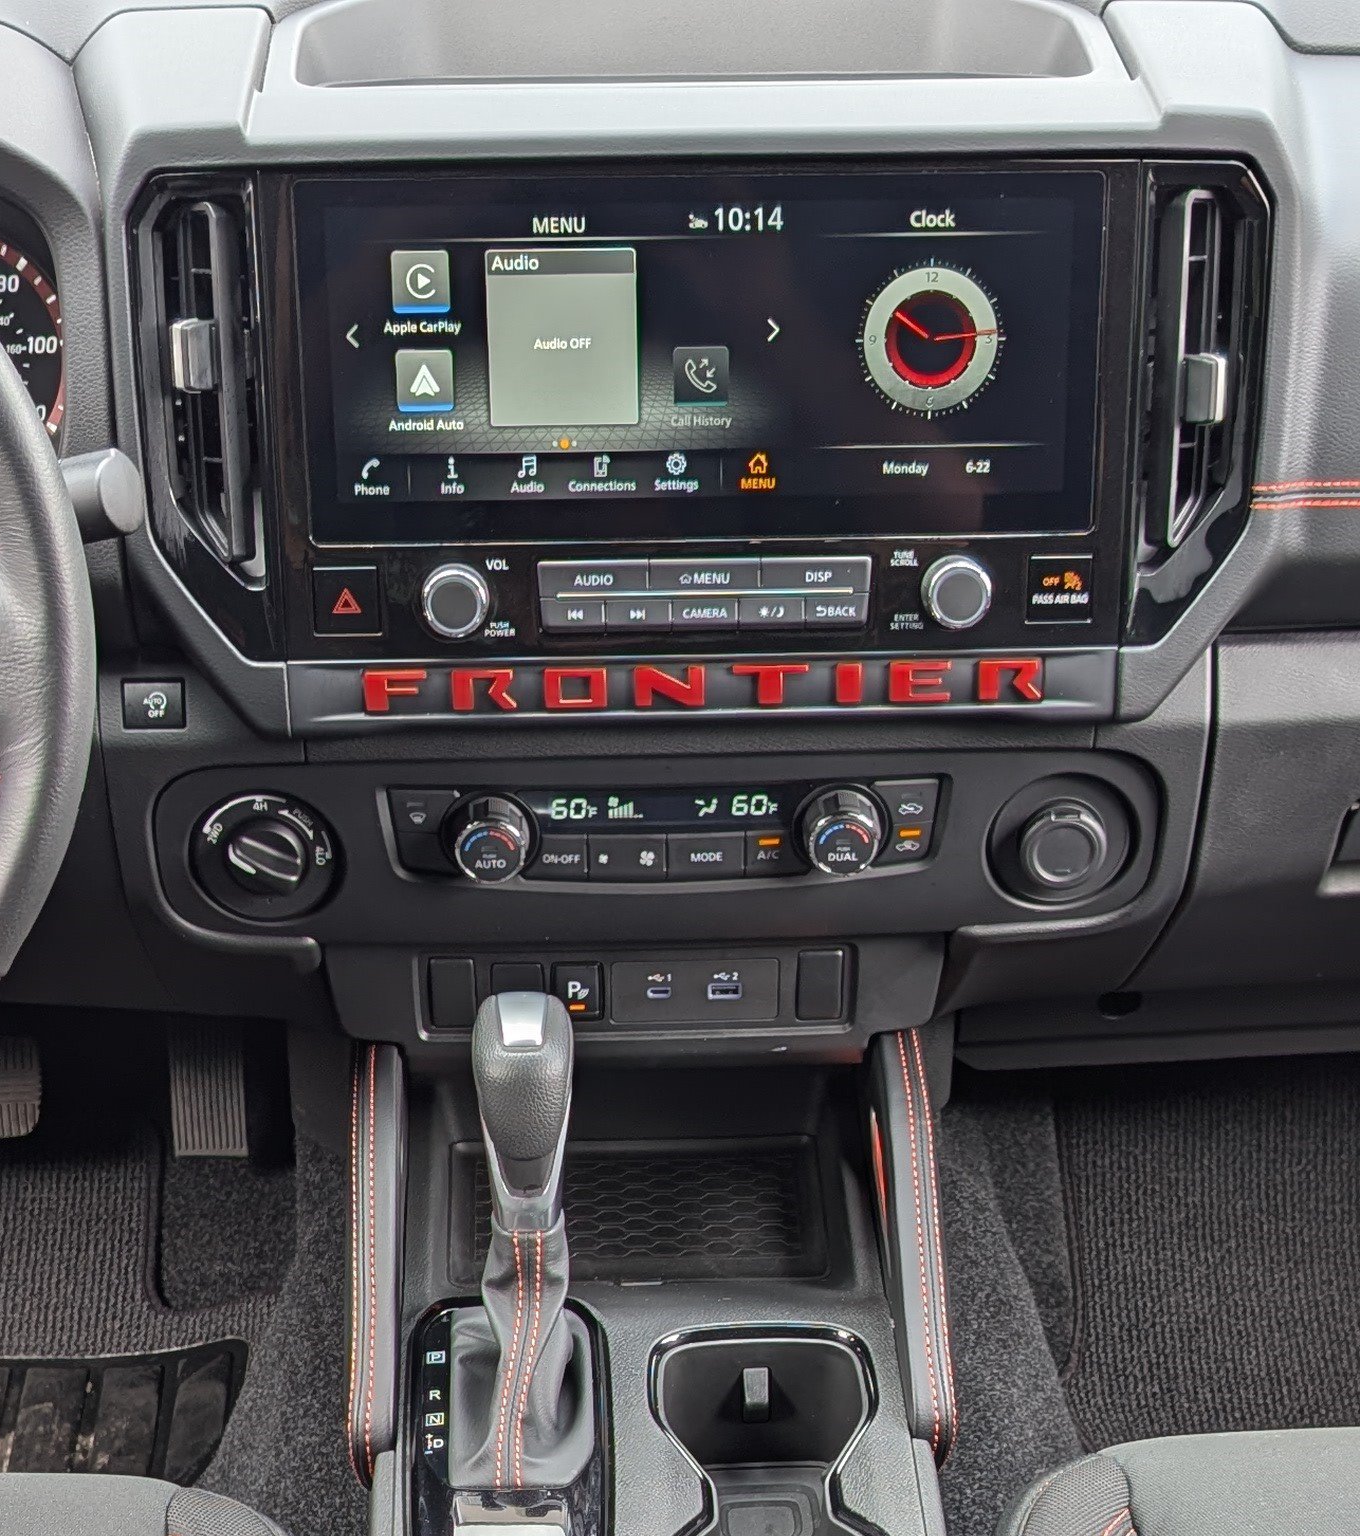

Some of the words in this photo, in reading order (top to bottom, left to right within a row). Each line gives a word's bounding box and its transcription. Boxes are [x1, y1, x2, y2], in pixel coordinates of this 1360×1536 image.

[714, 206, 785, 232] 10:14
[909, 209, 956, 228] Clock
[532, 217, 586, 234] MENU
[491, 255, 540, 271] Audio
[926, 271, 939, 283] 12
[383, 321, 418, 335] Apple
[419, 321, 462, 335] CarPlay
[27, 336, 58, 354] 100
[533, 338, 568, 350] Audio
[569, 338, 592, 349] OFF
[868, 334, 877, 346] 9
[389, 420, 434, 432] Android
[437, 419, 464, 431] Auto
[671, 415, 691, 426] Call
[693, 415, 732, 428] History
[882, 460, 929, 476] Monday
[966, 460, 991, 473] 6-22
[354, 484, 390, 496] Phone
[441, 483, 465, 494] Info
[510, 481, 545, 494] Audio
[568, 480, 637, 492] Connections
[654, 479, 700, 493] Settings
[741, 477, 776, 490] MENU
[485, 559, 509, 571] VOL
[890, 559, 919, 567] SCROLL
[574, 574, 614, 586] AUDIO
[694, 573, 730, 584] MENU
[805, 571, 832, 582] DISP
[1042, 577, 1061, 586] OFF
[1032, 594, 1054, 605] PASS
[1054, 593, 1069, 604] AIR
[1070, 592, 1089, 604] BAG
[682, 607, 728, 619] CAMERA
[827, 605, 856, 618] BACK
[484, 628, 516, 637] POWER
[361, 660, 1044, 712] FRONTIER
[148, 709, 165, 718] OFF
[252, 802, 269, 812] 4H
[293, 808, 314, 828] PUSH
[207, 822, 223, 845] 2WD
[315, 846, 327, 866] 4LO
[690, 852, 723, 863] MODE
[757, 850, 780, 860] A/C
[827, 852, 859, 862] DUAL
[475, 859, 507, 869] AUTO
[568, 981, 581, 999] P
[429, 1389, 441, 1401] R
[433, 1438, 444, 1449] D
